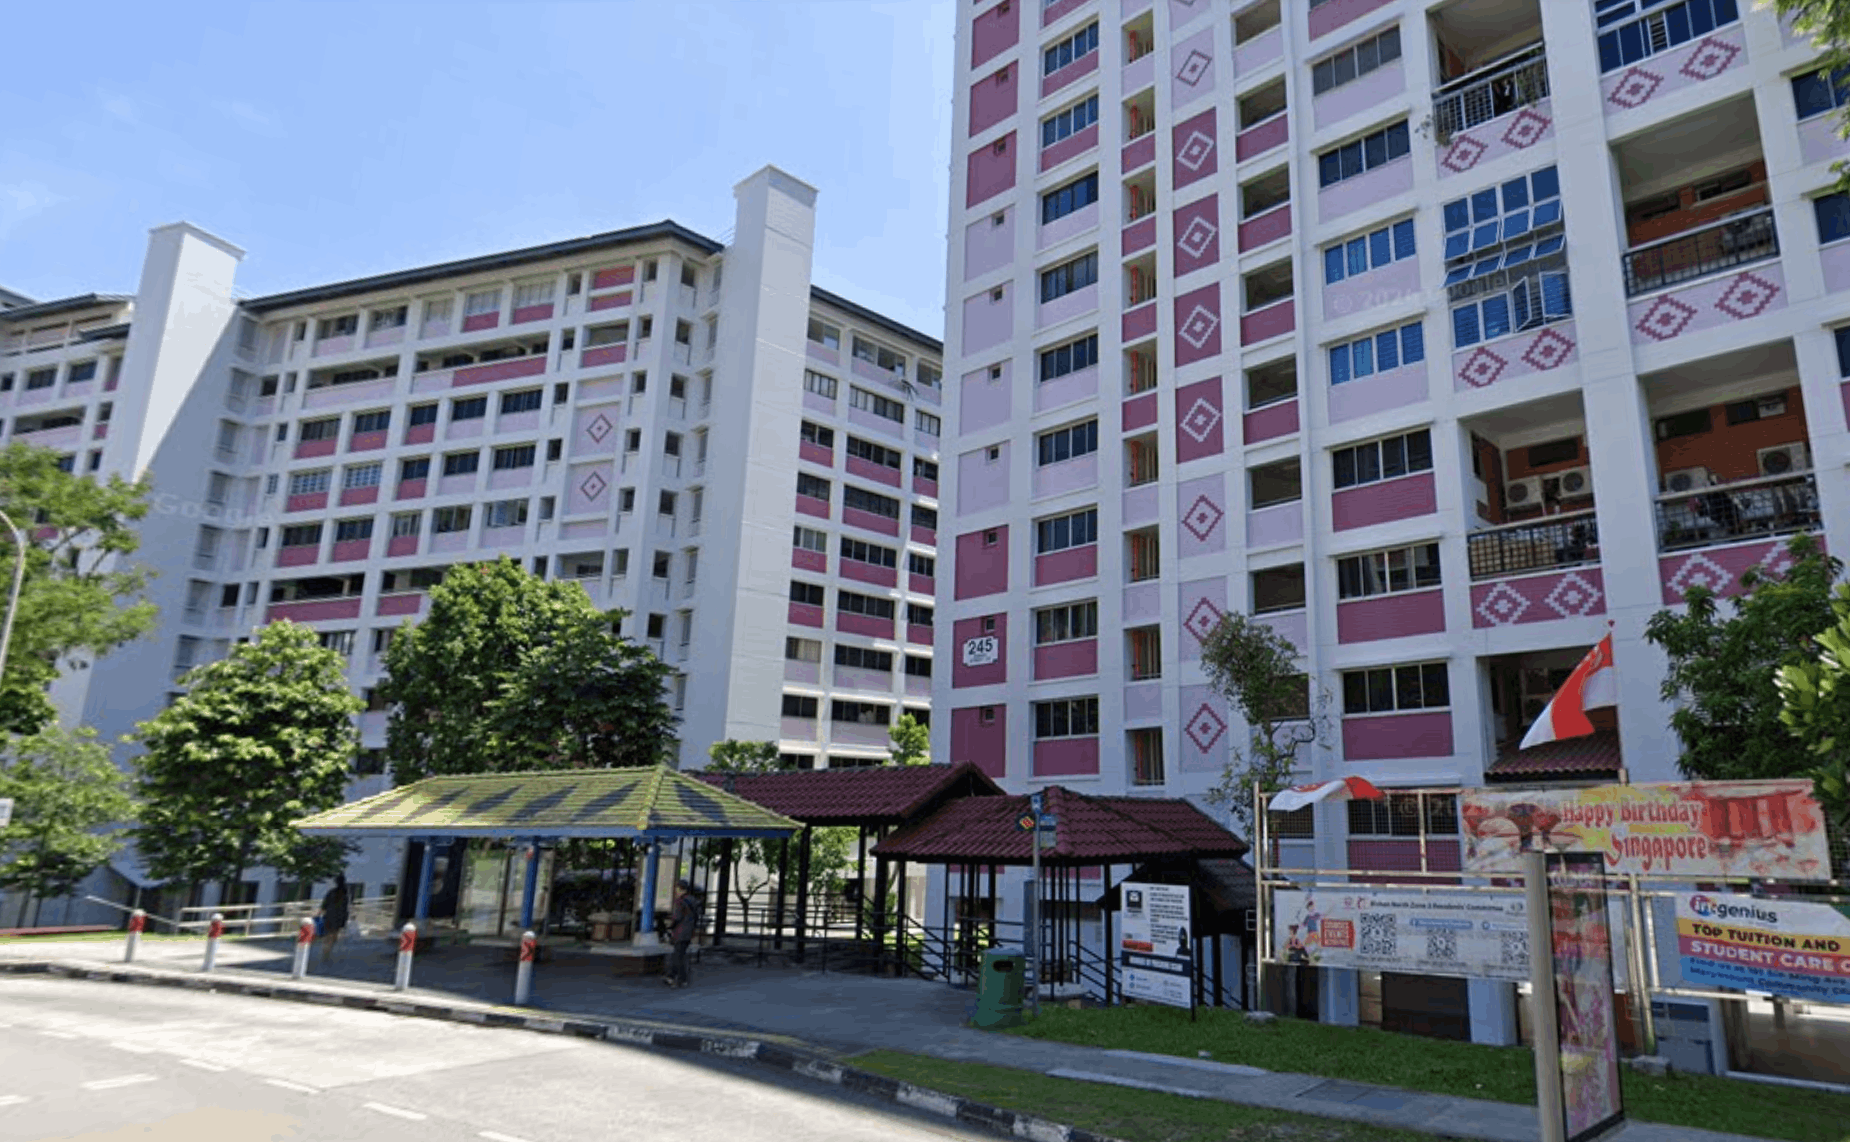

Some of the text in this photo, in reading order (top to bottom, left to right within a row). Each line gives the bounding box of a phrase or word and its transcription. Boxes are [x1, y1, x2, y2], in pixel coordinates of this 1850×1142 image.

[968, 638, 993, 655] 245
[1562, 798, 1701, 828] Happy Birthday
[1605, 832, 1707, 872] Singapore
[1691, 923, 1841, 953] TOP TUITION AND
[1691, 940, 1775, 965] STUDENT
[1780, 952, 1835, 973] CARE
